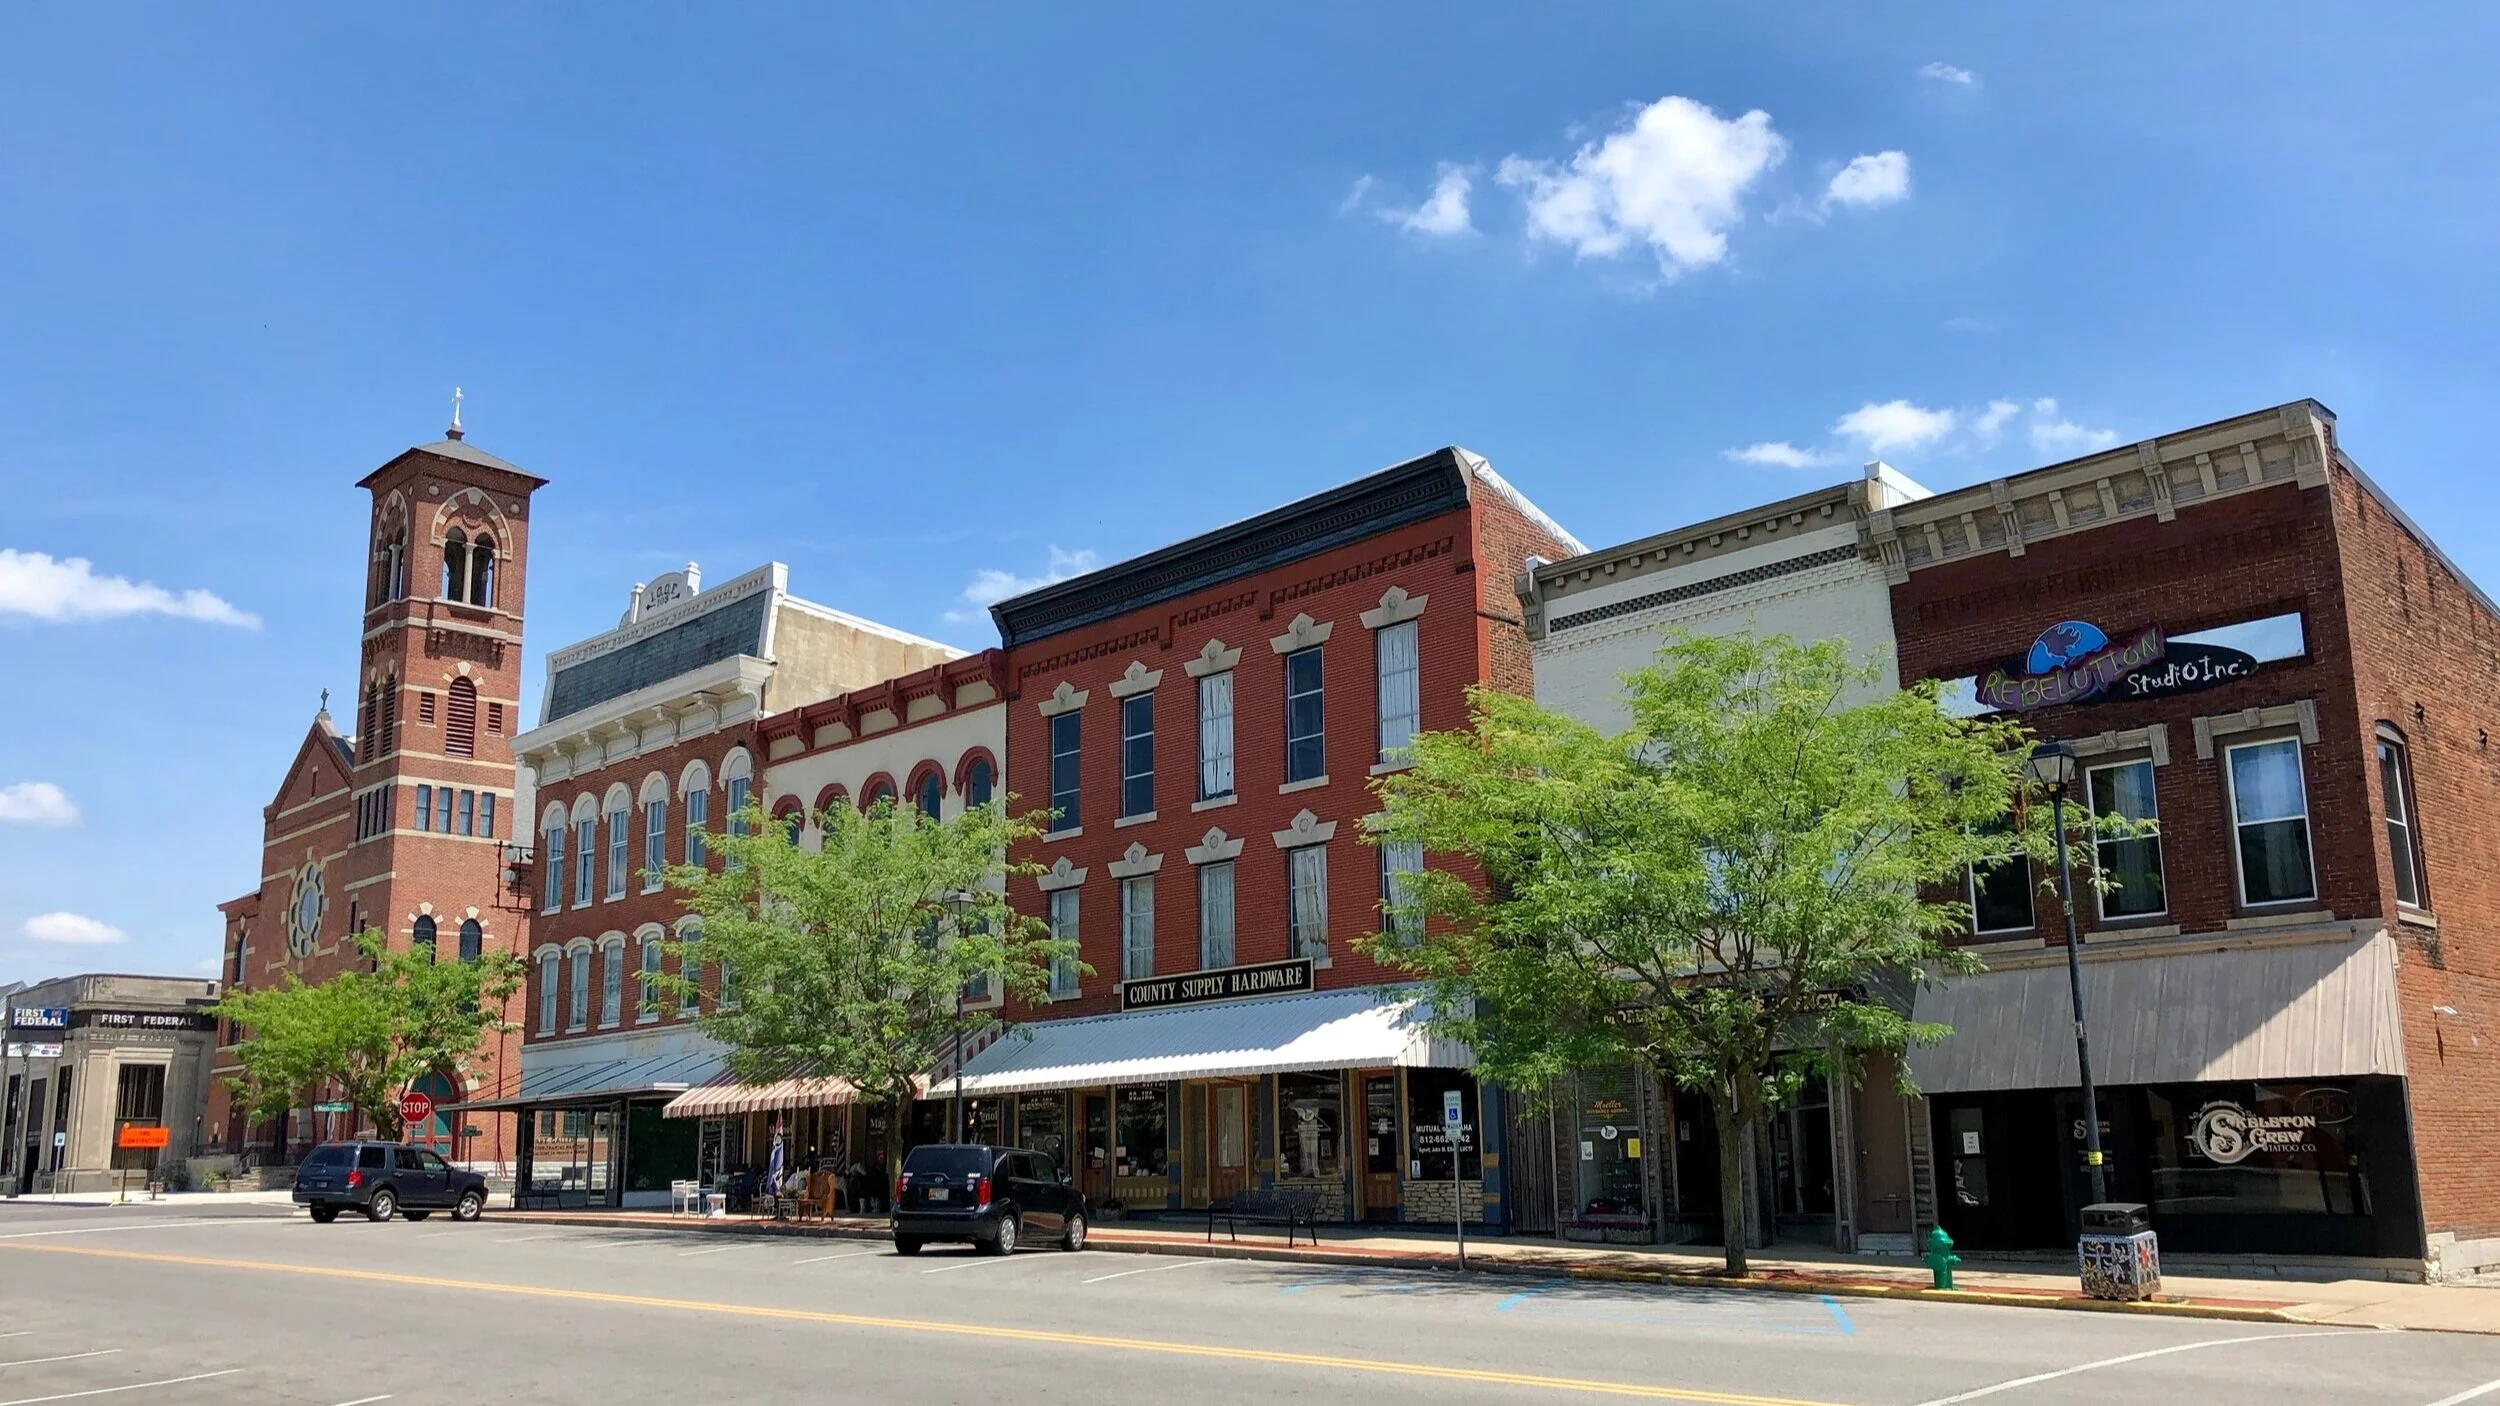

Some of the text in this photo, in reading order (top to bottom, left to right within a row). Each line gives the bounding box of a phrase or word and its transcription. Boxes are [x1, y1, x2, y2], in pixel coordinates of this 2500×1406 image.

[1981, 628, 2157, 706] REBELUTION
[1130, 967, 1303, 1004] COUNTY SUPPLY HARDWARE
[15, 1008, 45, 1018] FIRST
[14, 1017, 64, 1027] FEDERAL
[101, 1014, 194, 1026] FIRST FEDERAL
[402, 1101, 428, 1113] STOP
[2267, 1144, 2317, 1152] TATTOO CO.
